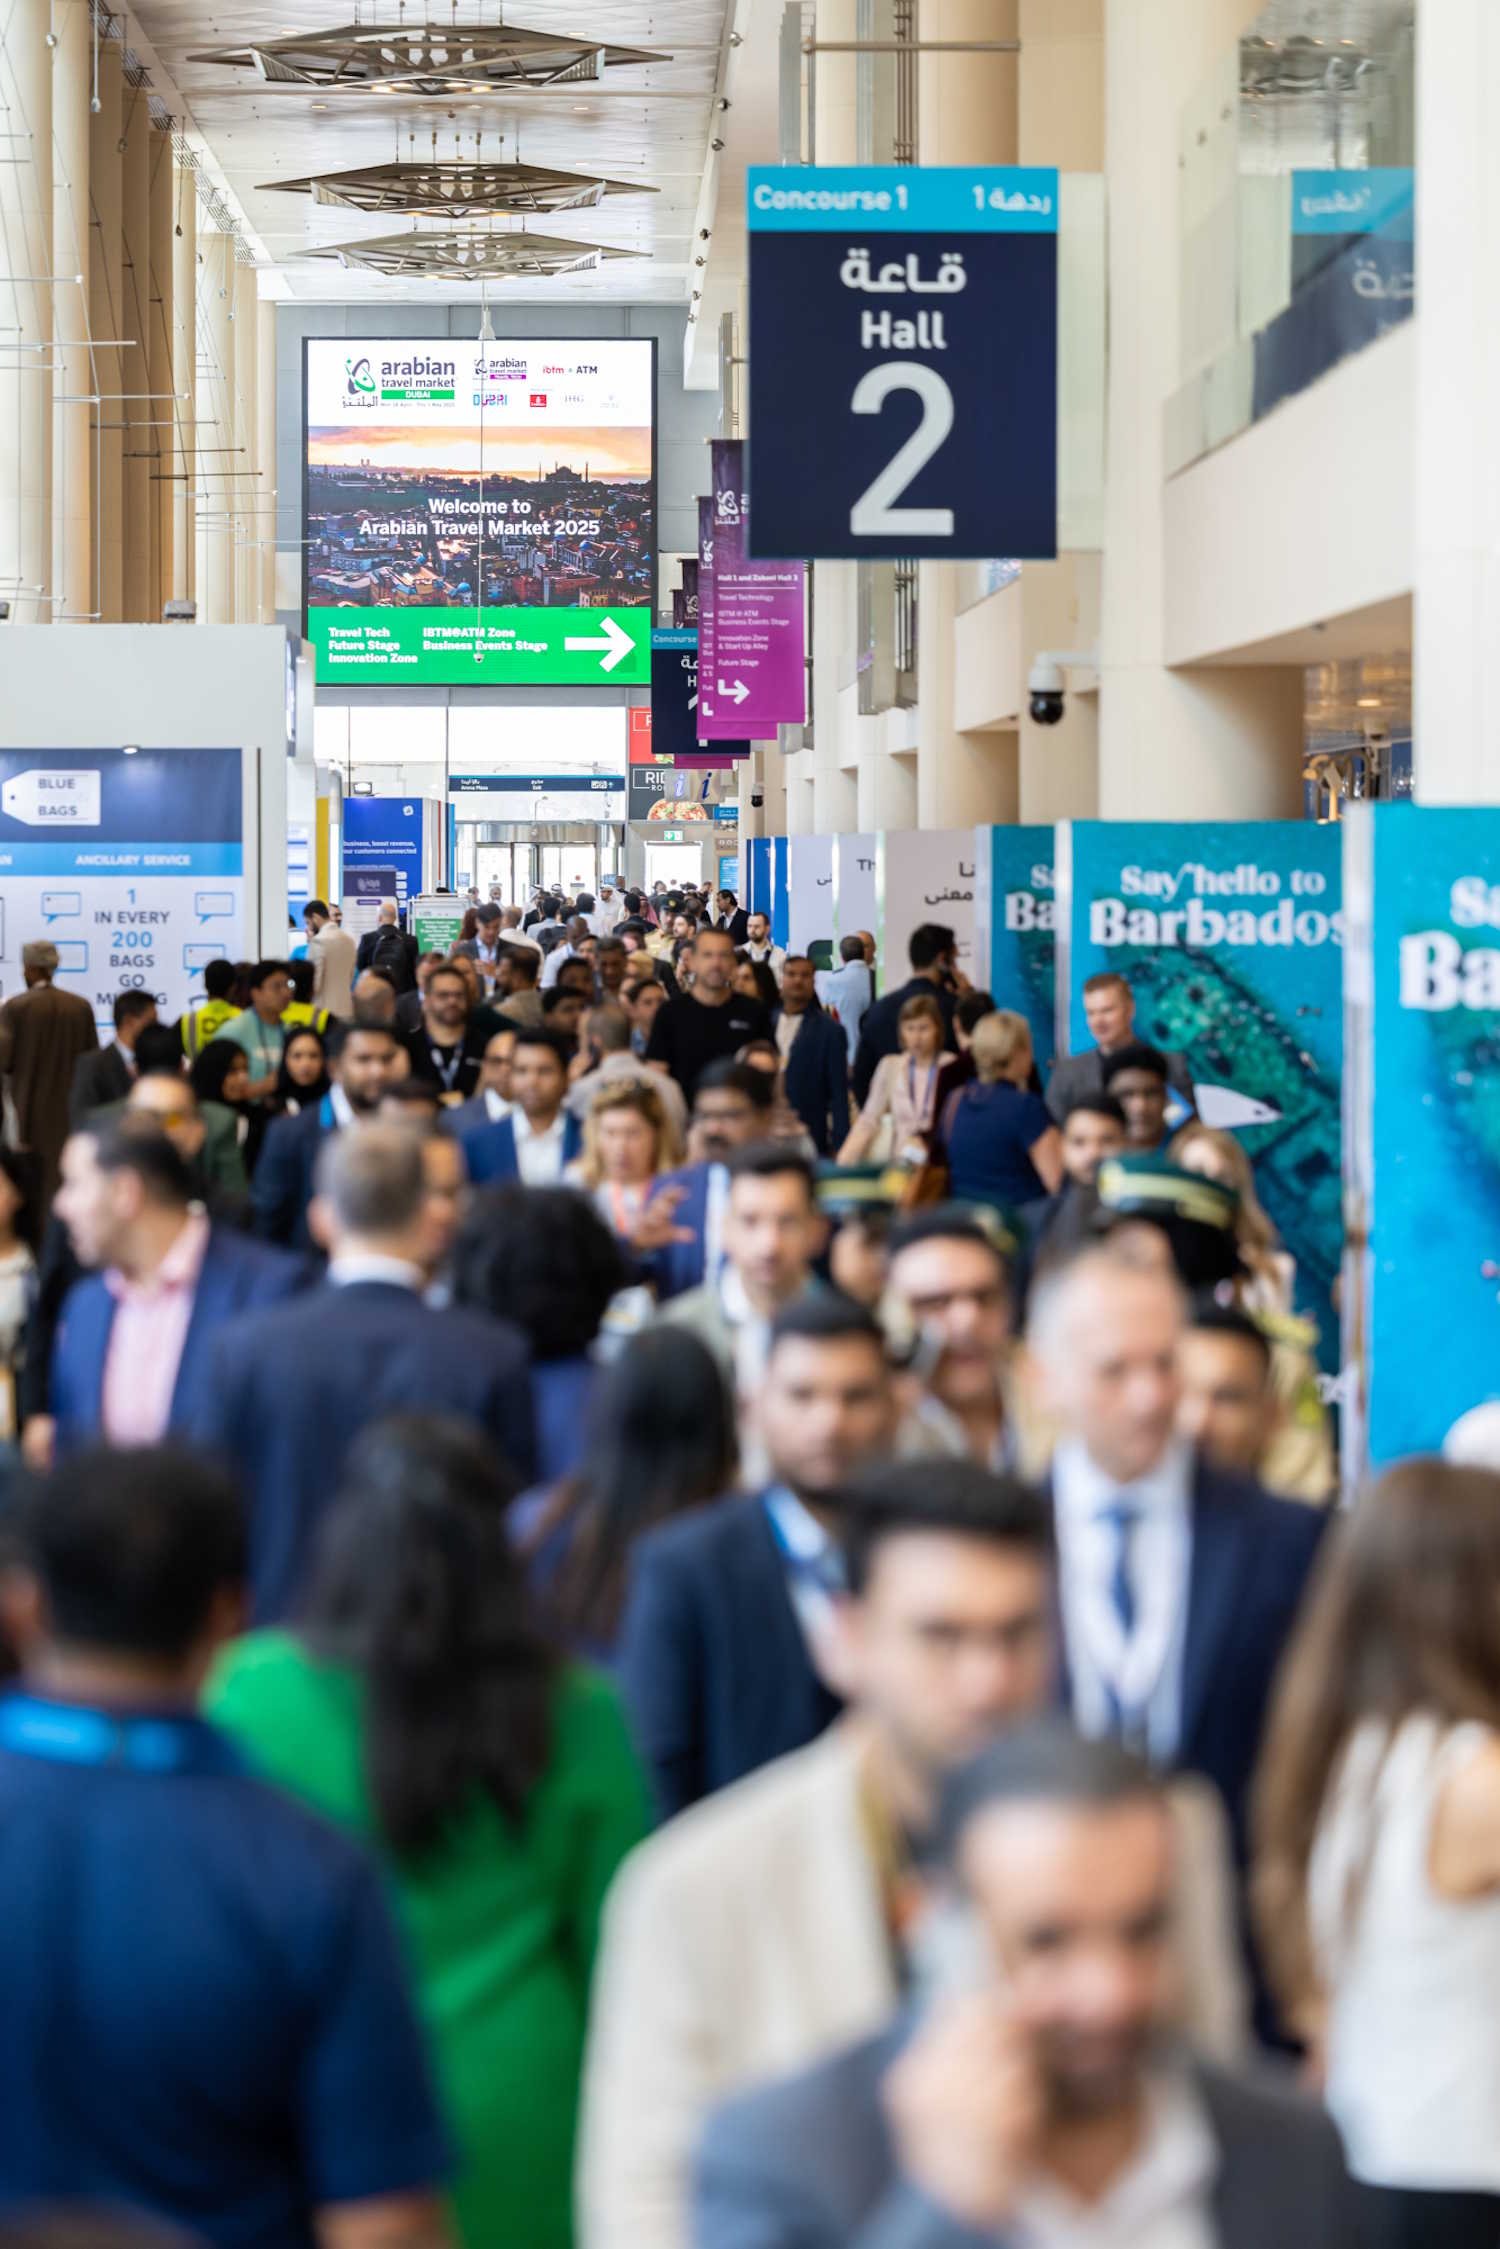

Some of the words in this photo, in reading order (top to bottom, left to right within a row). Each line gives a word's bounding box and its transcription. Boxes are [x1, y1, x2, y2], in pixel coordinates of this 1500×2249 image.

[753, 184, 892, 211] Concourse
[896, 184, 908, 210] 1
[973, 185, 986, 210] 1
[988, 187, 1051, 214] ردهة
[840, 247, 967, 293] قاعة
[861, 310, 948, 350] Hall
[381, 356, 455, 375] arabian
[489, 357, 527, 368] arabian
[576, 366, 598, 374] ATM
[381, 378, 413, 388] travel
[416, 378, 455, 388] market
[405, 390, 431, 398] DUBAI
[850, 361, 955, 536] 2
[428, 498, 507, 514] Welcome
[512, 499, 531, 514] to
[360, 519, 428, 535] Arabian
[432, 519, 483, 535] Travel
[488, 519, 550, 535] Market
[554, 519, 600, 535] 2025
[328, 627, 362, 638] Travel
[364, 627, 390, 638] Tech
[488, 627, 516, 638] Zone
[328, 640, 365, 650] Future
[367, 640, 400, 652] Stage
[423, 640, 473, 650] Business
[476, 640, 512, 650] Events
[516, 640, 548, 652] Stage
[328, 653, 388, 664] Innovation
[390, 653, 418, 664] Zone
[38, 778, 76, 789] BLUE
[38, 806, 78, 817] BAGS
[75, 855, 140, 866] ANCILLARY
[143, 855, 192, 866] SERVICE
[1120, 862, 1186, 903] Say
[1193, 862, 1281, 896] hello
[1290, 869, 1326, 896] to
[127, 889, 136, 904] 1
[94, 912, 111, 924] IN
[117, 912, 170, 924] EVERY
[111, 931, 153, 948] 200
[110, 955, 155, 967] BAGS
[119, 974, 145, 987] GO
